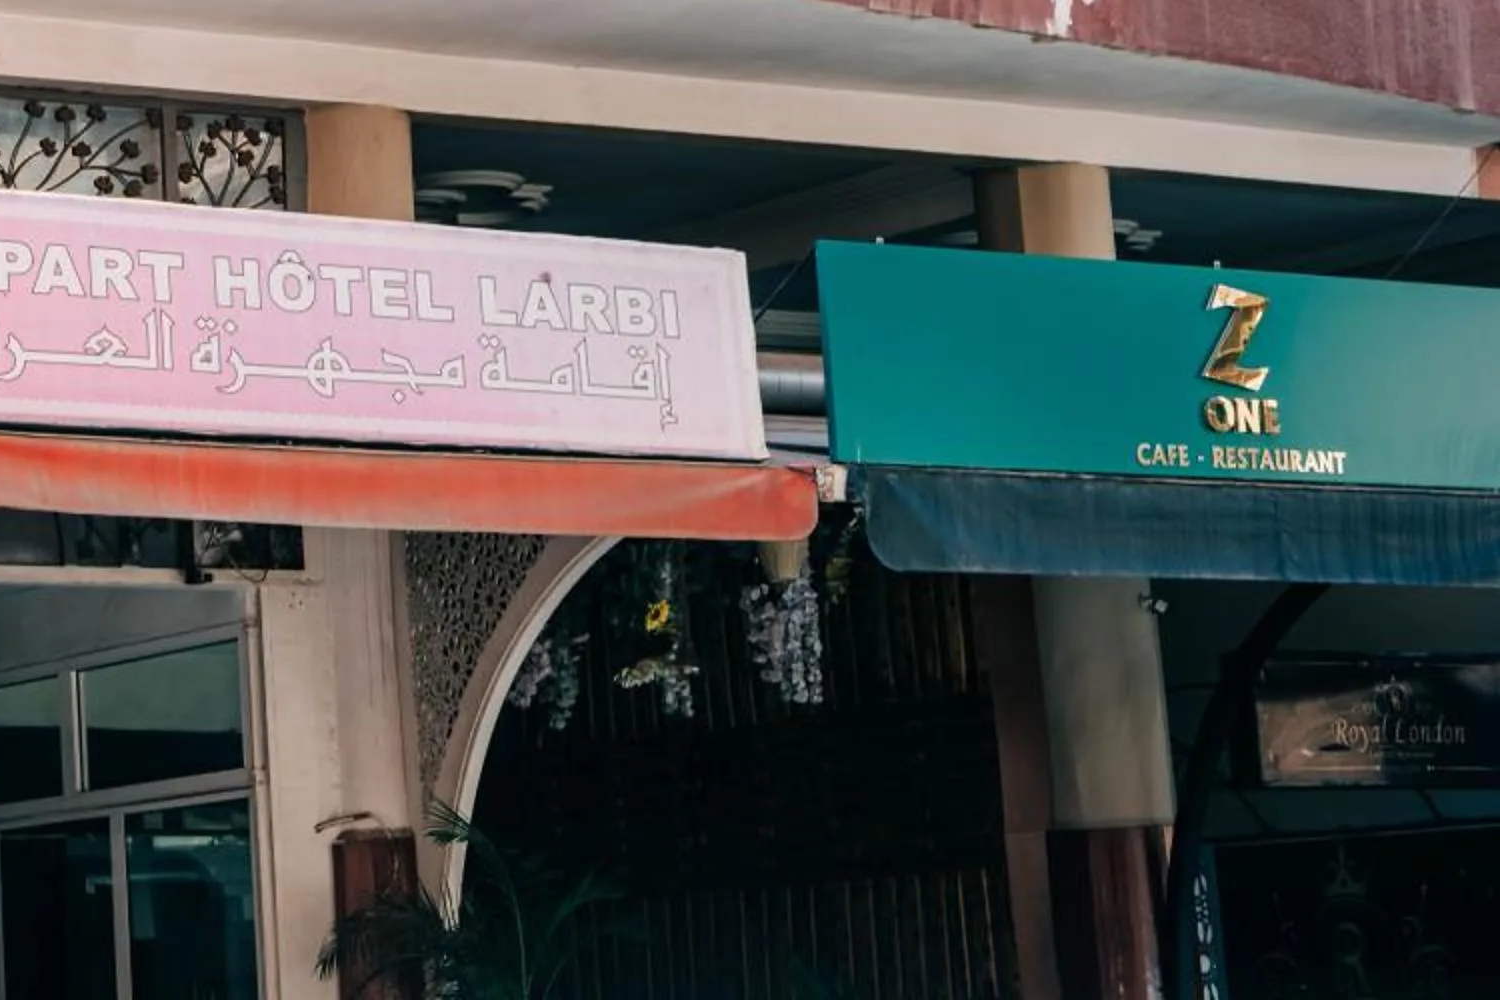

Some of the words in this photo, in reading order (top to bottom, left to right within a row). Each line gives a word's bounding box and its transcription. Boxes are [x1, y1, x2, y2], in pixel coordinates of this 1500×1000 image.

[213, 249, 455, 323] HÔTEL
[478, 275, 681, 339] LARBI
[190, 312, 467, 404] مجهزة
[1201, 283, 1269, 391] Z
[1204, 395, 1281, 435] ONE
[1136, 442, 1190, 468] CAFE
[1211, 445, 1347, 475] RESTAURANT
[1330, 715, 1387, 751] Royal
[1395, 714, 1466, 745] London
